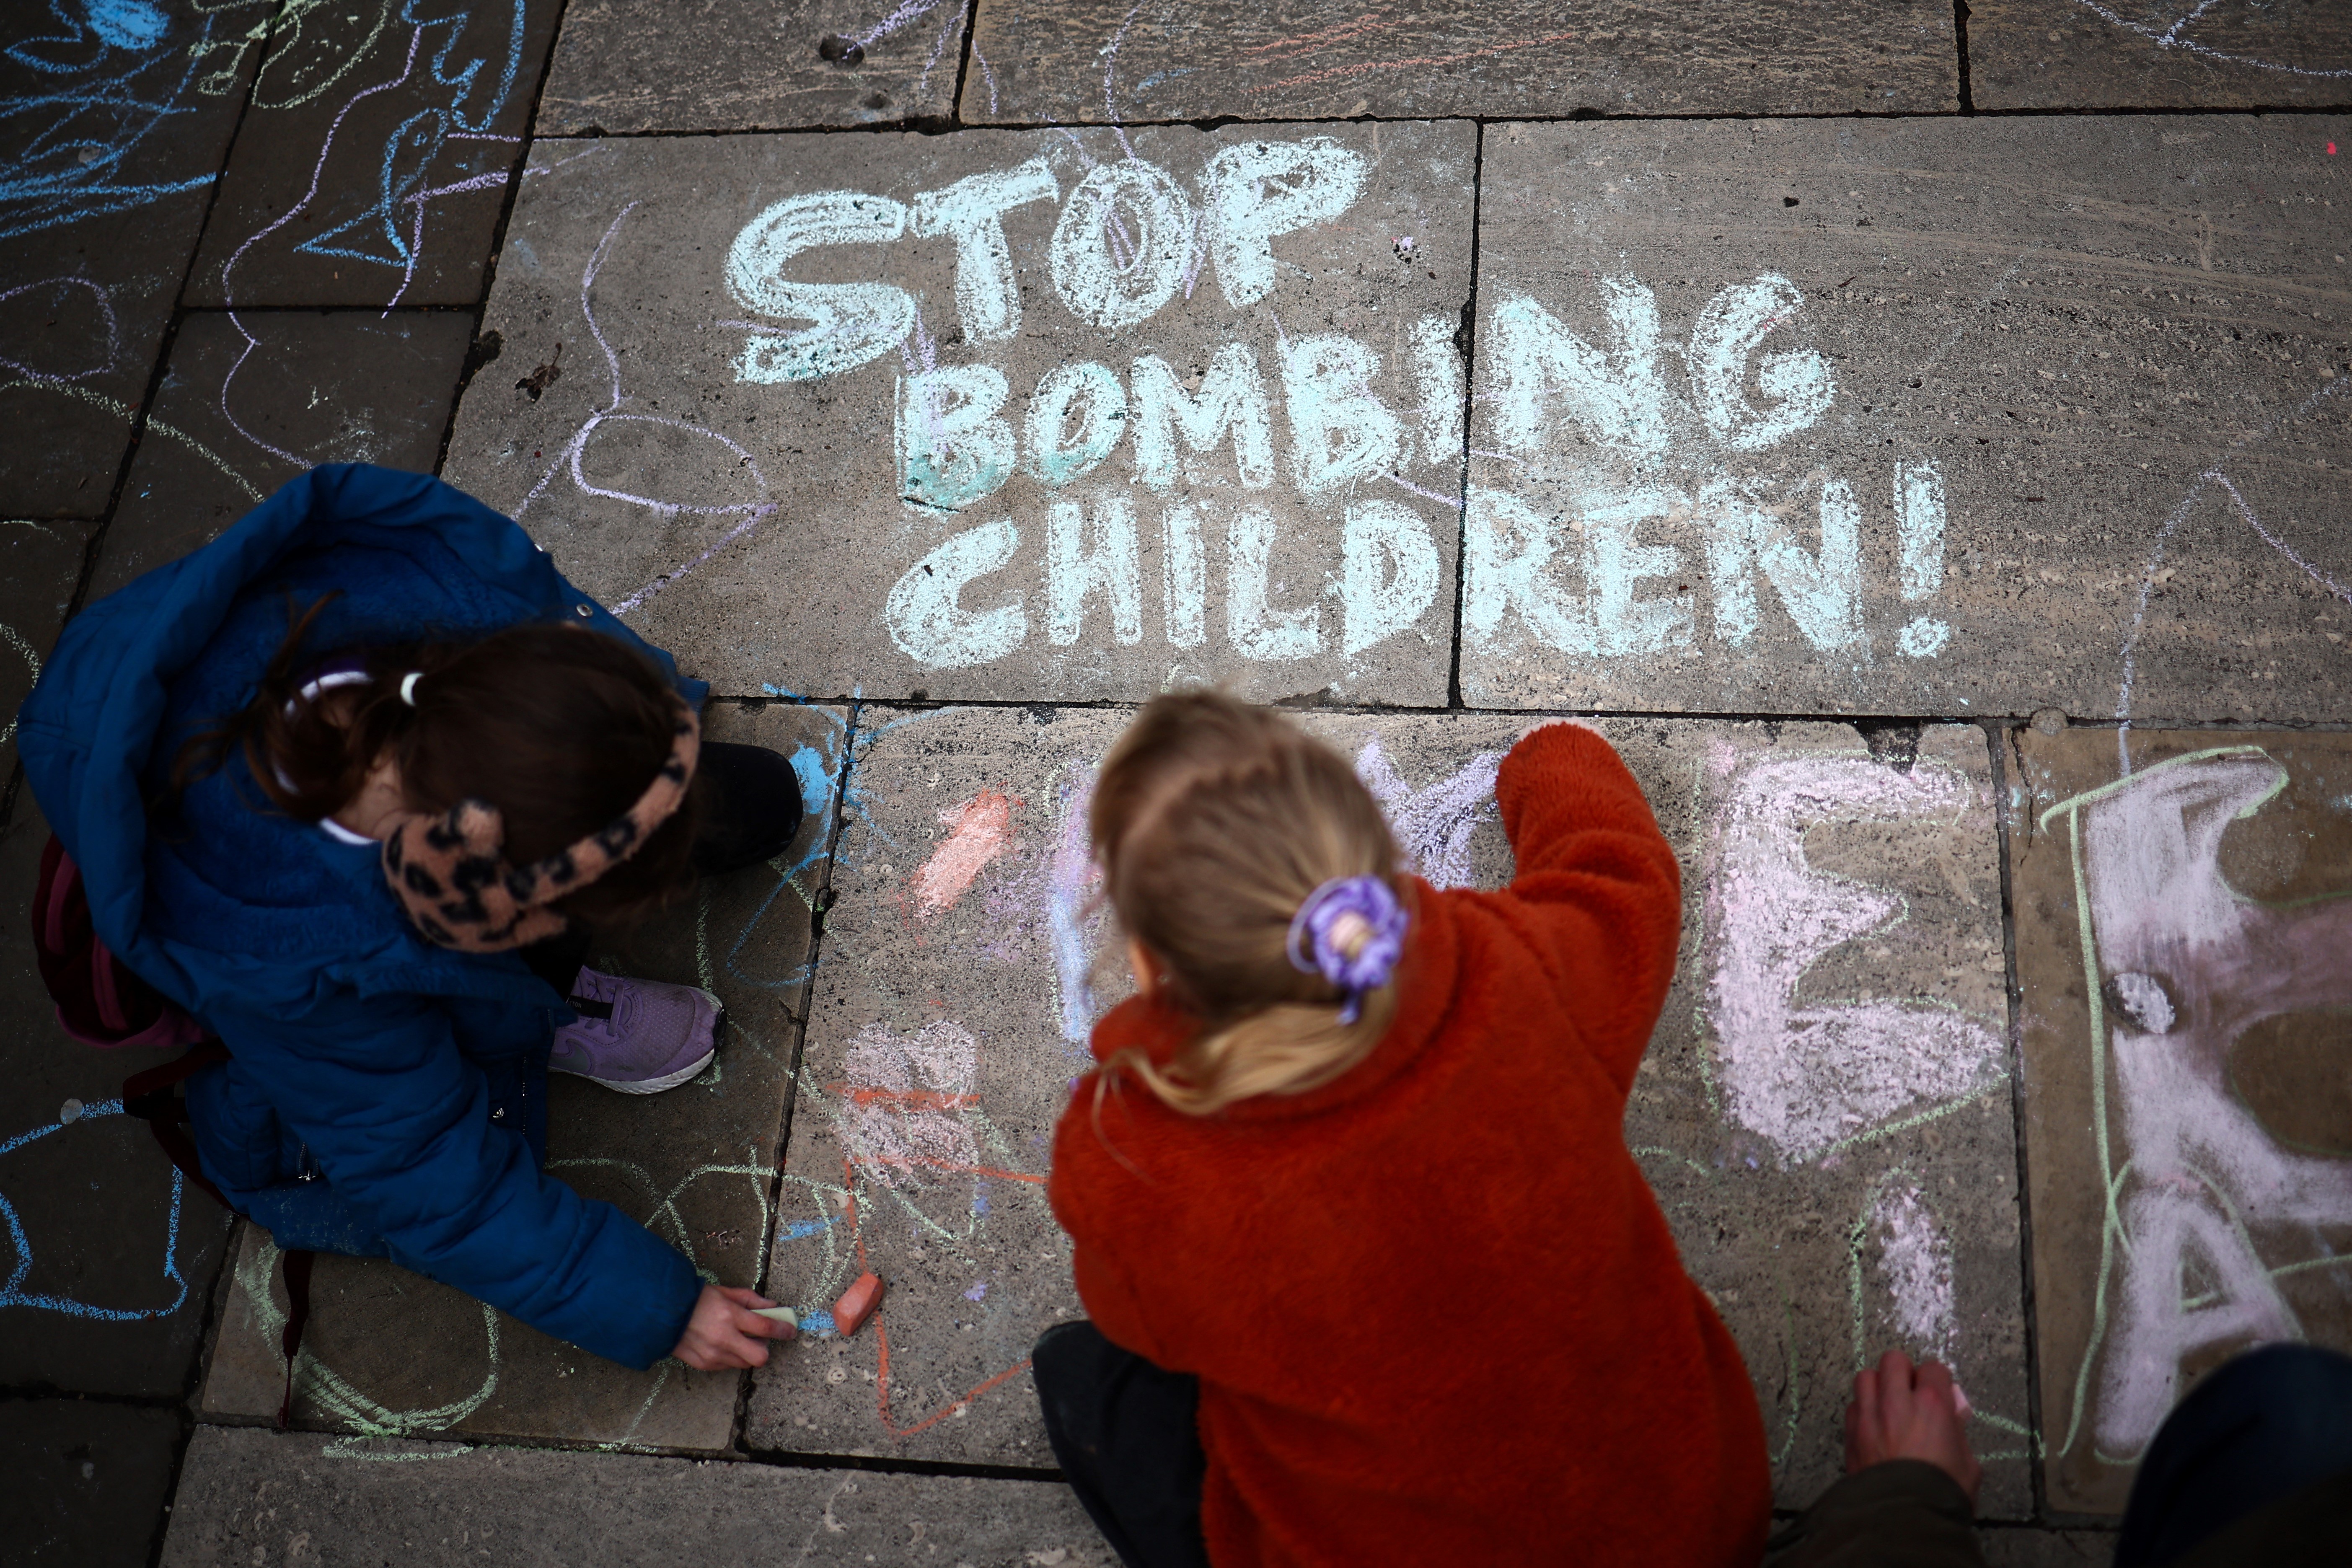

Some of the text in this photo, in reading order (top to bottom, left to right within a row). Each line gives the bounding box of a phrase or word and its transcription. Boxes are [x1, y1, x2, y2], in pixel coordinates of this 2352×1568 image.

[723, 136, 1369, 383] STOP
[893, 272, 1837, 513] BOMBING
[884, 458, 1951, 665] CHILDREN!
